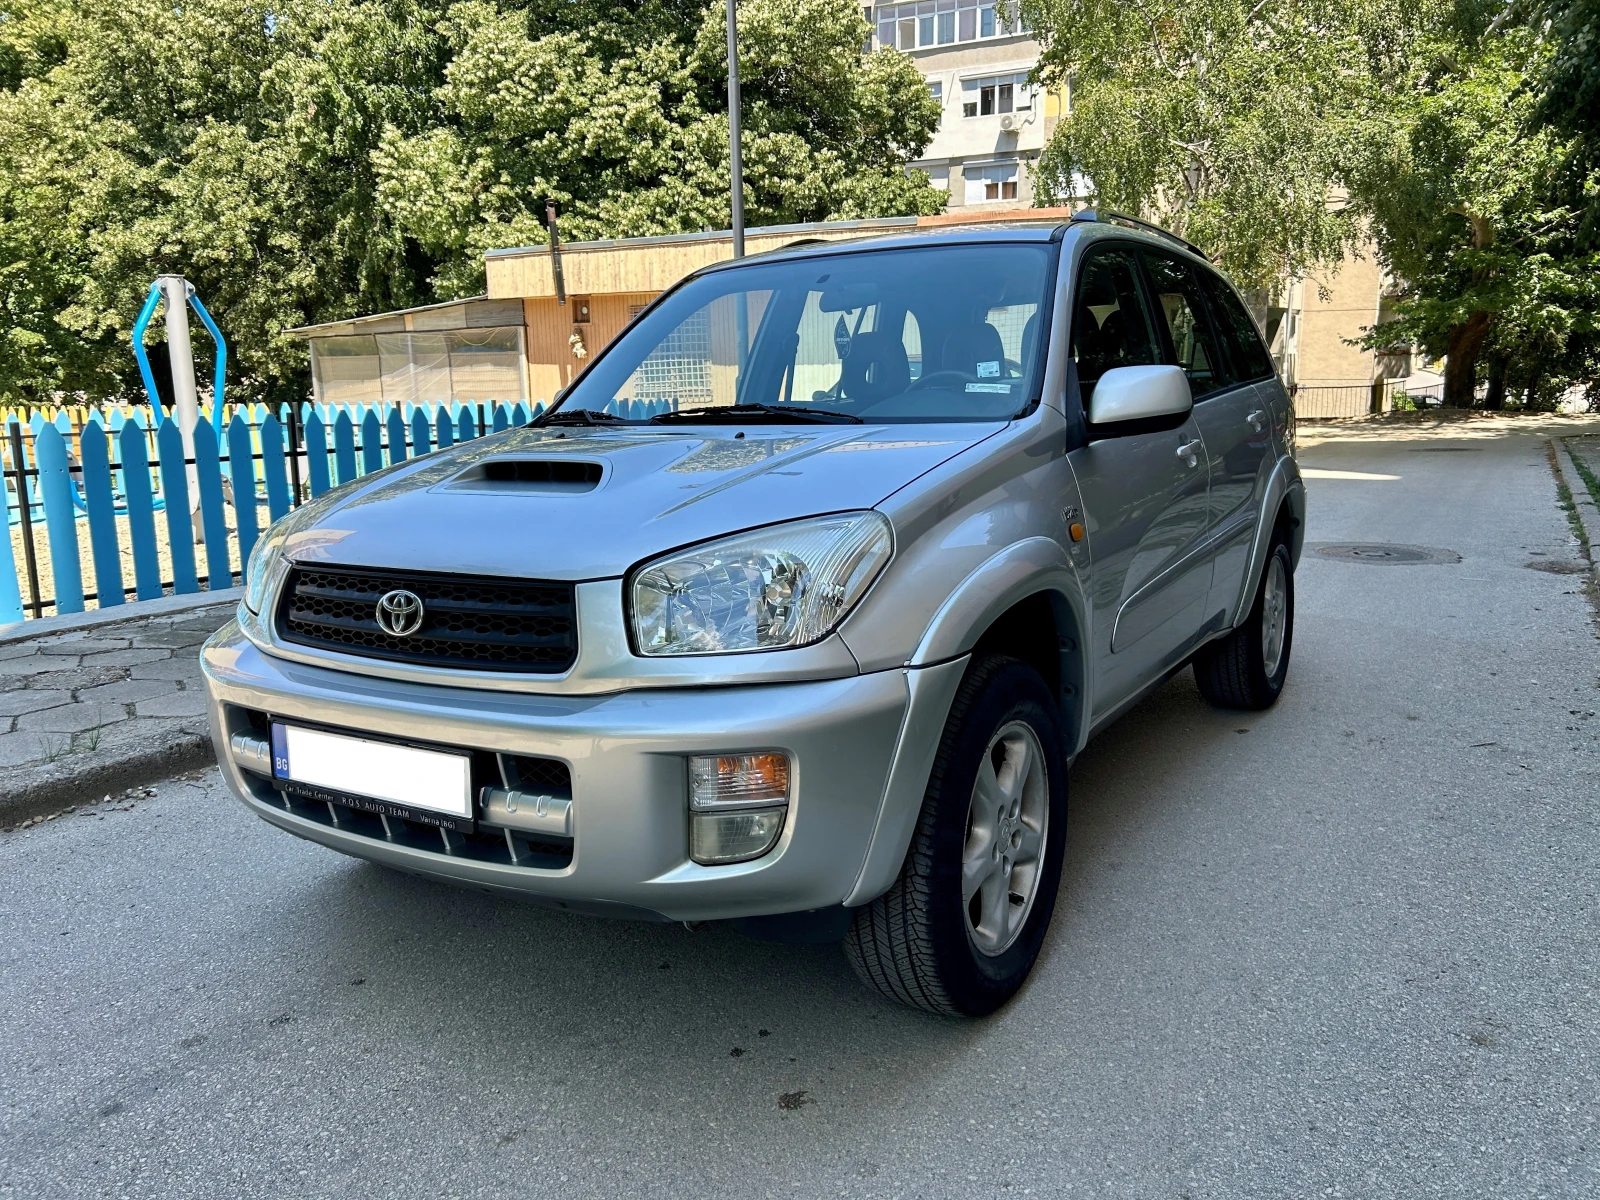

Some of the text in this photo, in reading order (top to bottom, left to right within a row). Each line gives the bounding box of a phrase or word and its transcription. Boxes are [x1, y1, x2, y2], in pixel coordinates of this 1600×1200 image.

[276, 757, 288, 771] BG
[285, 784, 295, 792] Car
[297, 787, 313, 797] Trade
[314, 791, 335, 802] Center
[420, 814, 440, 826] Varna
[441, 820, 455, 830] (BG)
